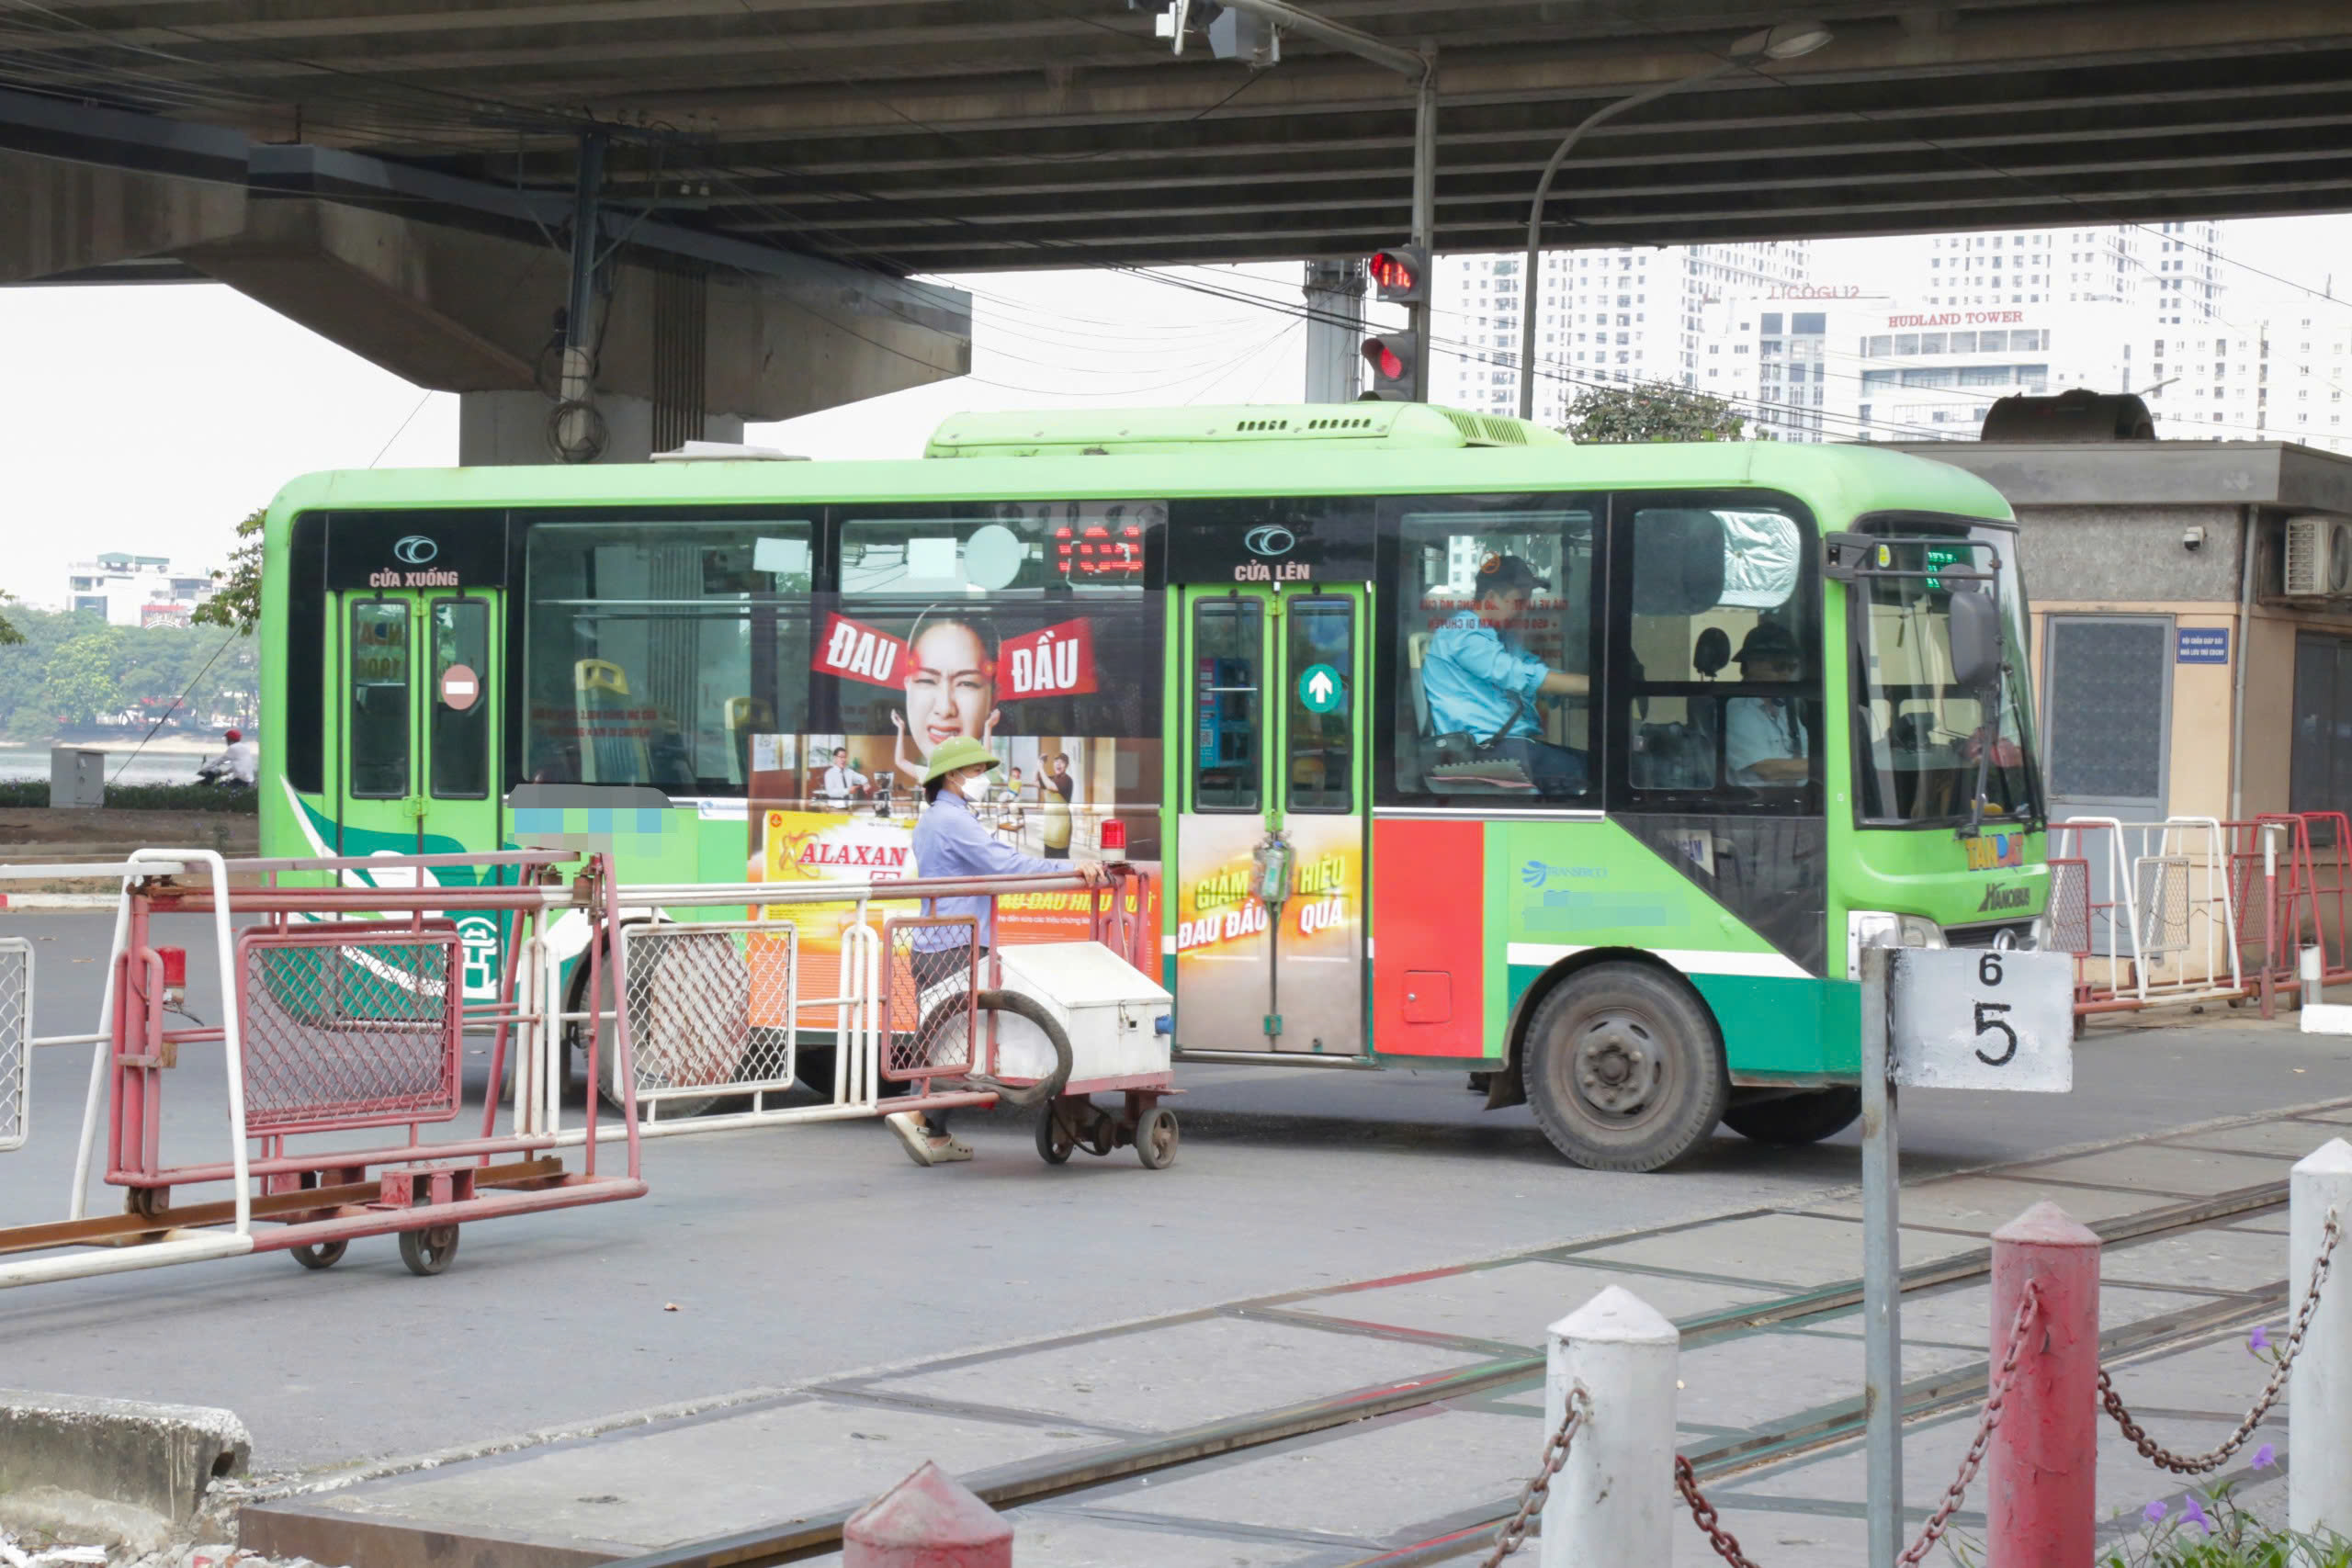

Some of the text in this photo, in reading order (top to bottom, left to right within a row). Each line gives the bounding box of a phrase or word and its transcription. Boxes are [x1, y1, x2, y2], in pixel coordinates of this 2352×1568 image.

[1888, 310, 2024, 328] HUDLAND TOWER
[369, 566, 459, 588] CỬA XUỐNG
[1234, 558, 1311, 581] CỬA LÊN
[826, 621, 898, 682] ĐAU
[1012, 630, 1079, 694] ĐẦU
[797, 842, 909, 867] ALAXAN
[1196, 864, 1251, 911] GIẢM
[1976, 882, 2030, 913] HANOIBUS
[1179, 898, 1270, 950] ĐAU ĐẦU
[1979, 953, 2004, 987] 6
[1974, 1001, 2018, 1067] 5
